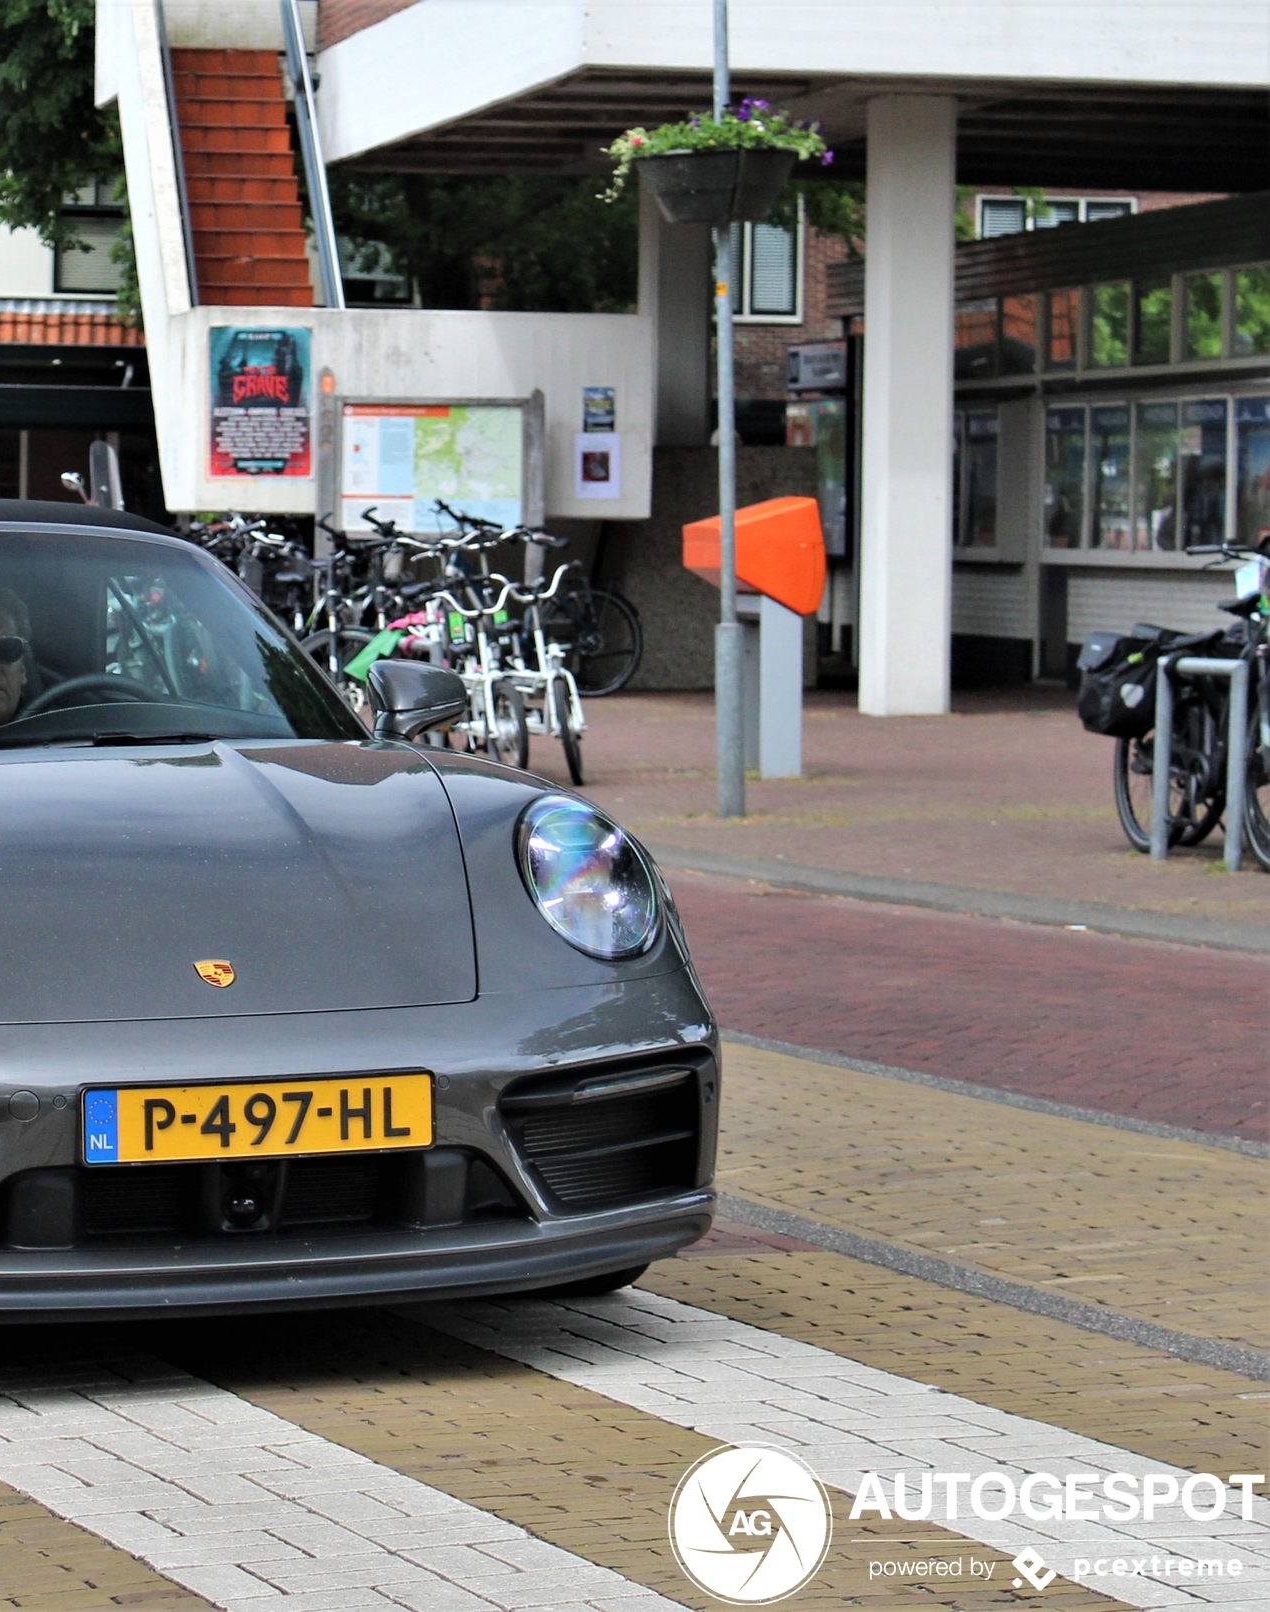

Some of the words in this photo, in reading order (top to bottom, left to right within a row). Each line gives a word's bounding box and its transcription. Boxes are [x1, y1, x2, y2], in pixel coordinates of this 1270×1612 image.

[233, 375, 290, 404] GRAVE
[90, 1133, 113, 1151] NL
[143, 1087, 411, 1151] P-497-HL
